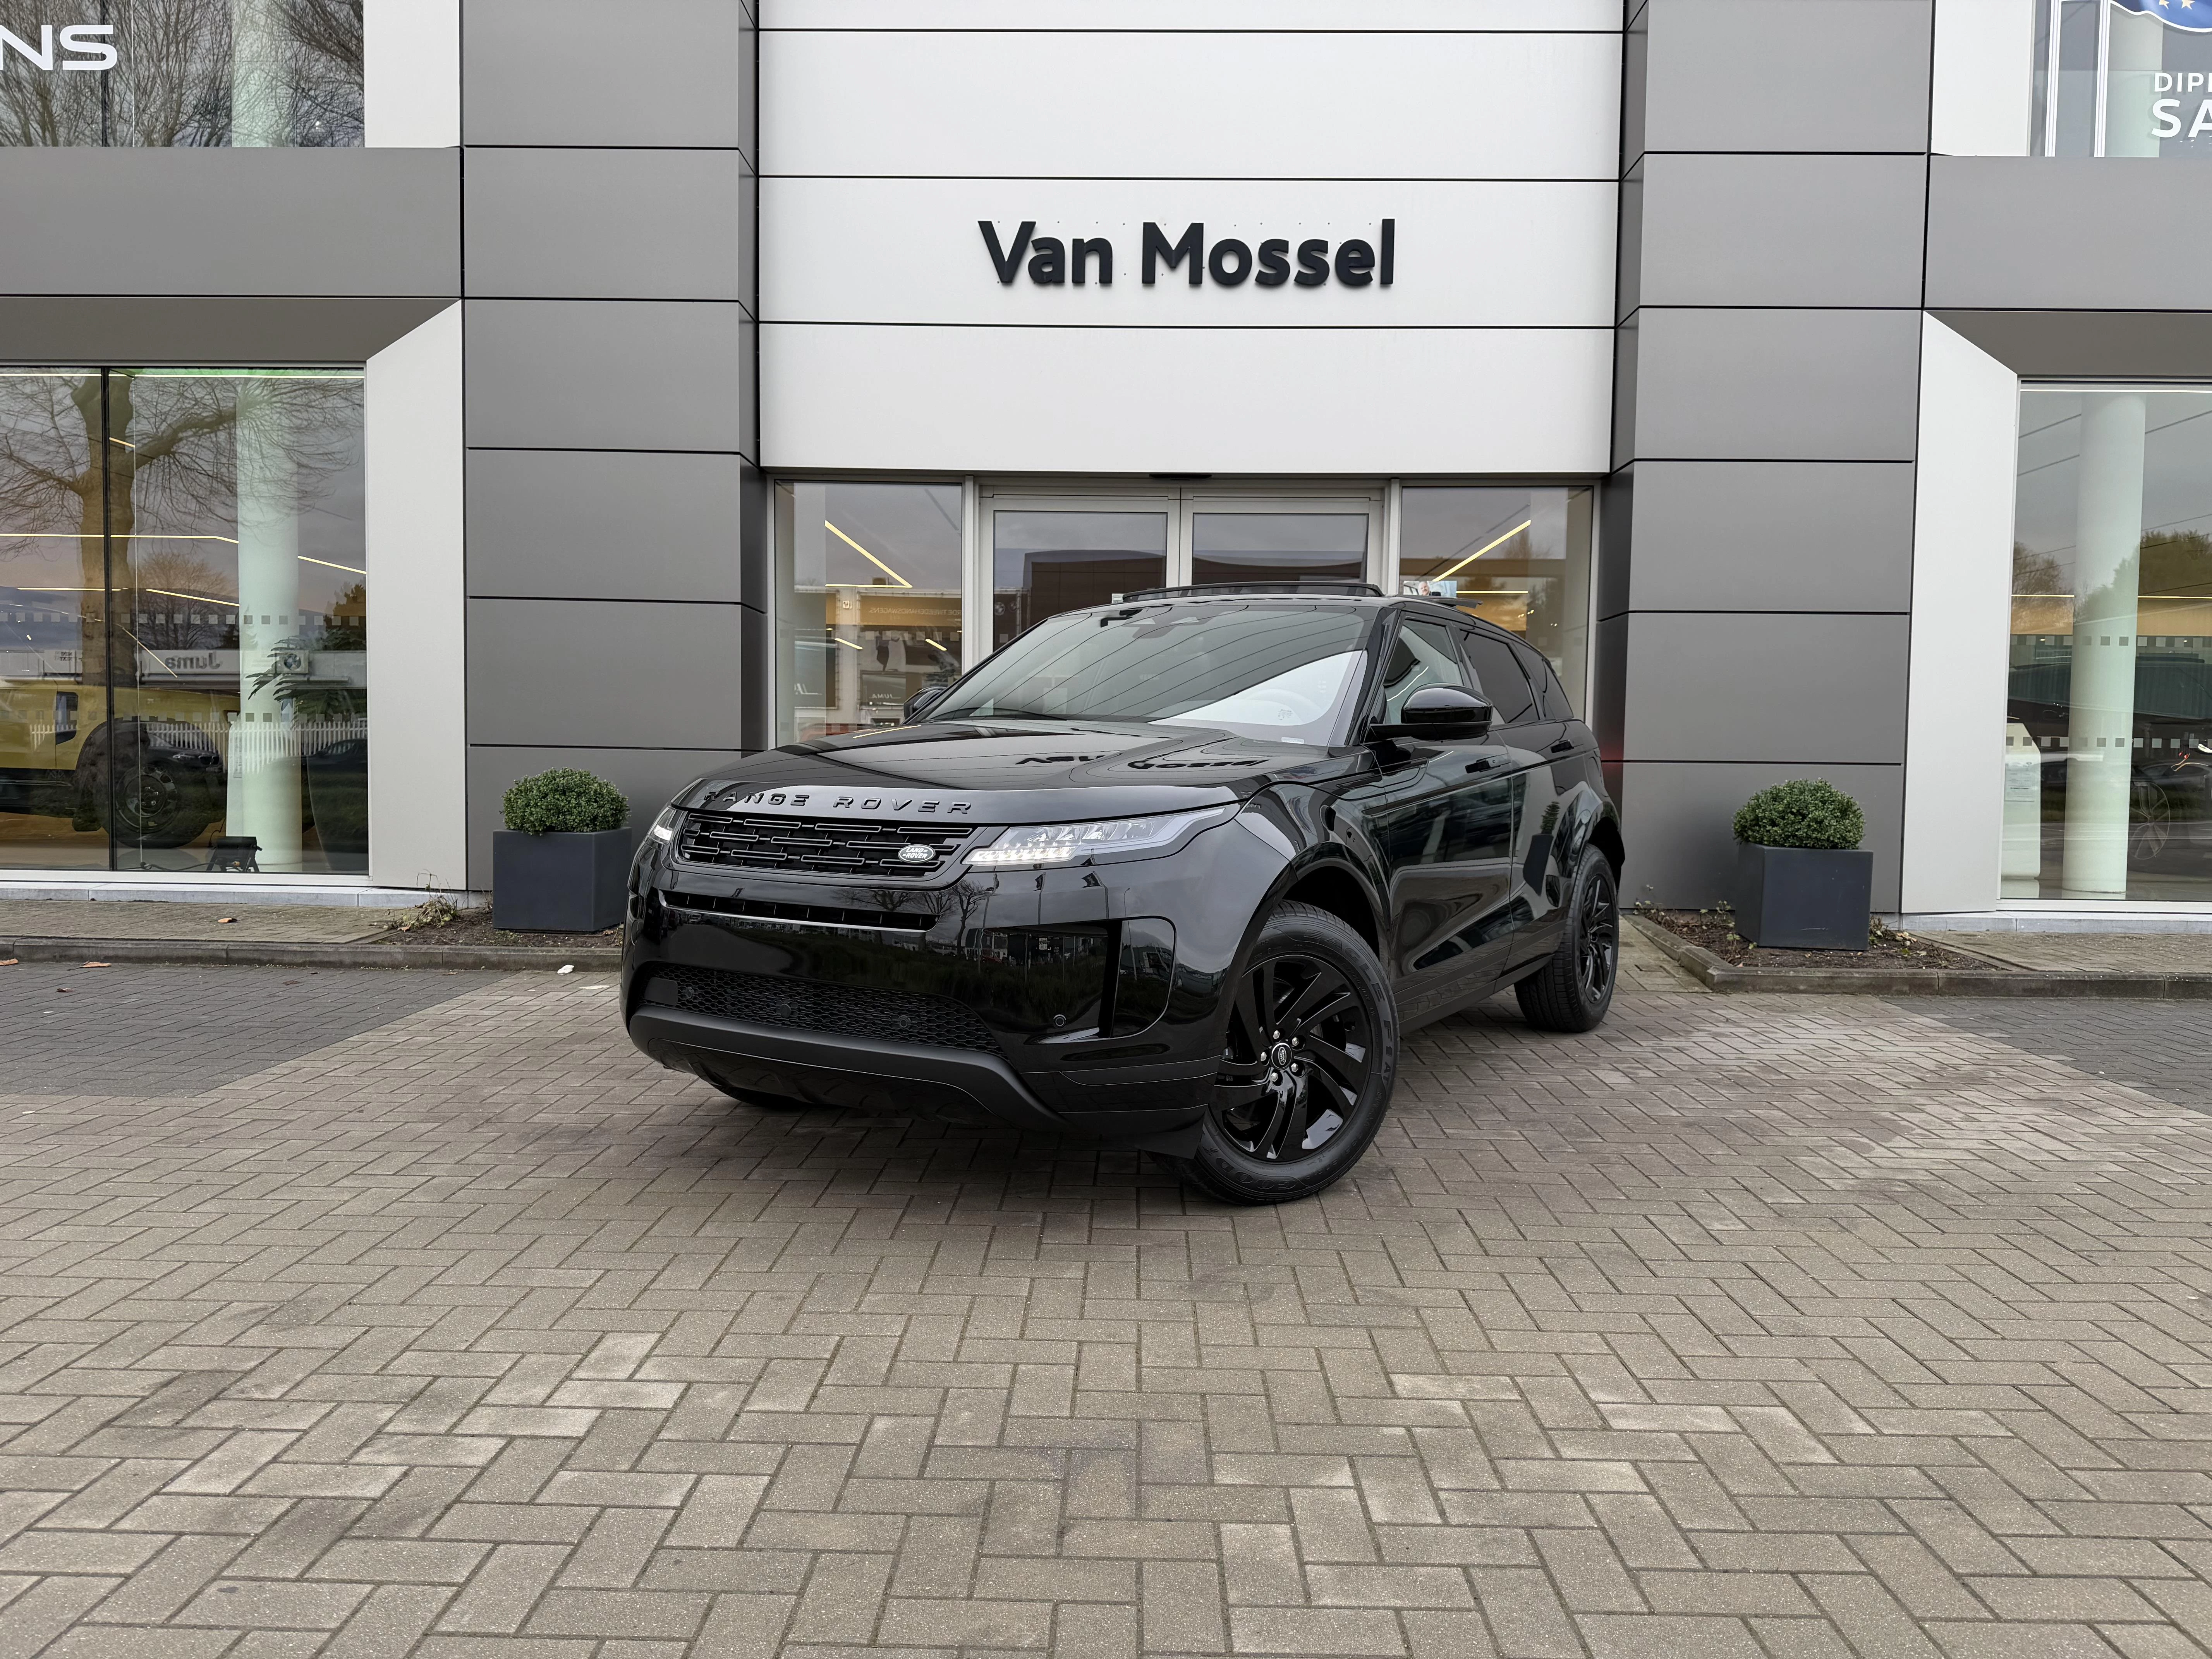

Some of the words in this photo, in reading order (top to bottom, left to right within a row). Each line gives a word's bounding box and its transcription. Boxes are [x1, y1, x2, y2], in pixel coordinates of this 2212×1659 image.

[2154, 72, 2212, 92] DIP
[977, 220, 1113, 285] Van
[1142, 218, 1395, 287] Mossel
[704, 791, 809, 806] RANGE
[833, 796, 971, 814] ROVER
